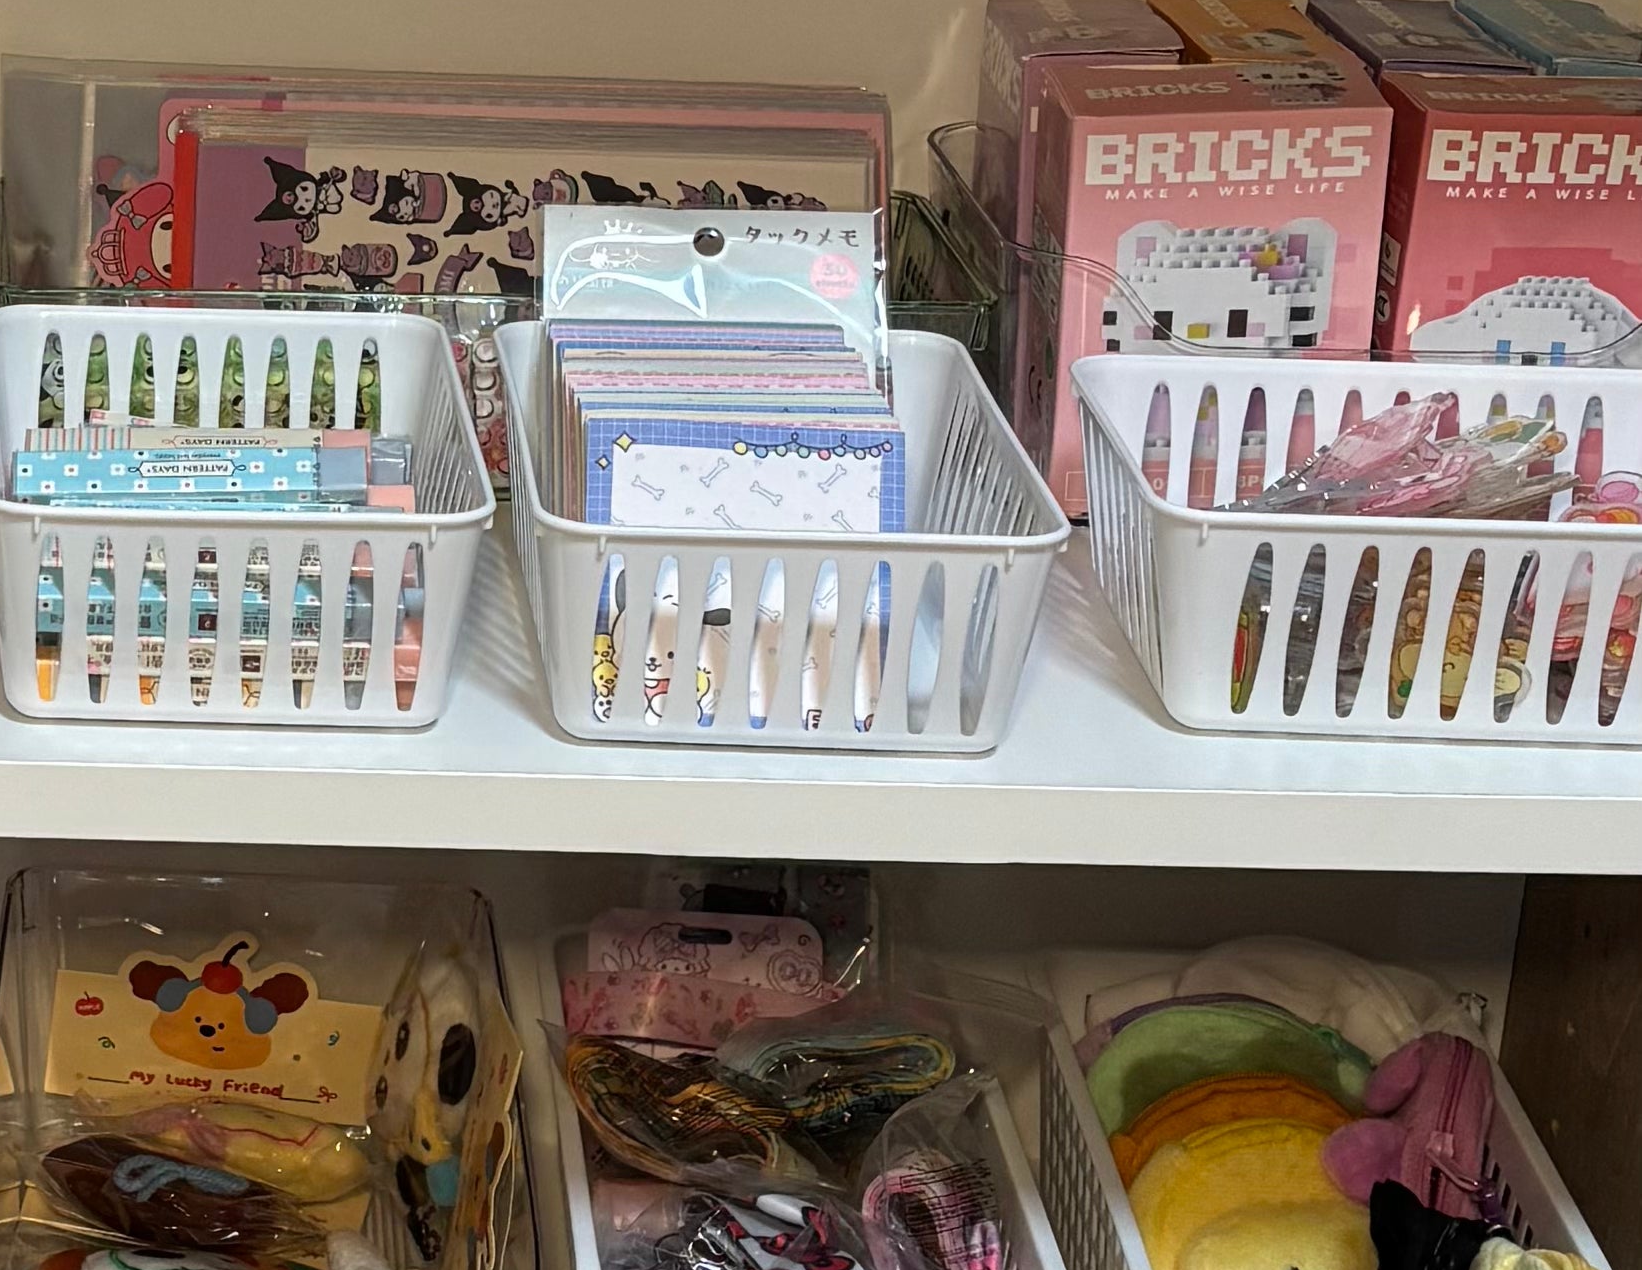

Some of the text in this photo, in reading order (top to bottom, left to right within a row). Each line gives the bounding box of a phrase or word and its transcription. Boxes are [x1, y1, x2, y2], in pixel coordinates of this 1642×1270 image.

[1085, 82, 1231, 100] BRICKS
[1085, 126, 1372, 185] BRICKS
[1105, 182, 1345, 201] MAKE A WISE LIFE
[1445, 186, 1507, 199] MAKE
[1526, 188, 1537, 200] A
[1556, 189, 1609, 201] WISE
[745, 225, 859, 248] タックメモ
[216, 438, 261, 446] PATTERN
[183, 464, 229, 473] PATTERN
[166, 1075, 212, 1091] Lucky
[223, 1079, 284, 1098] Friend
